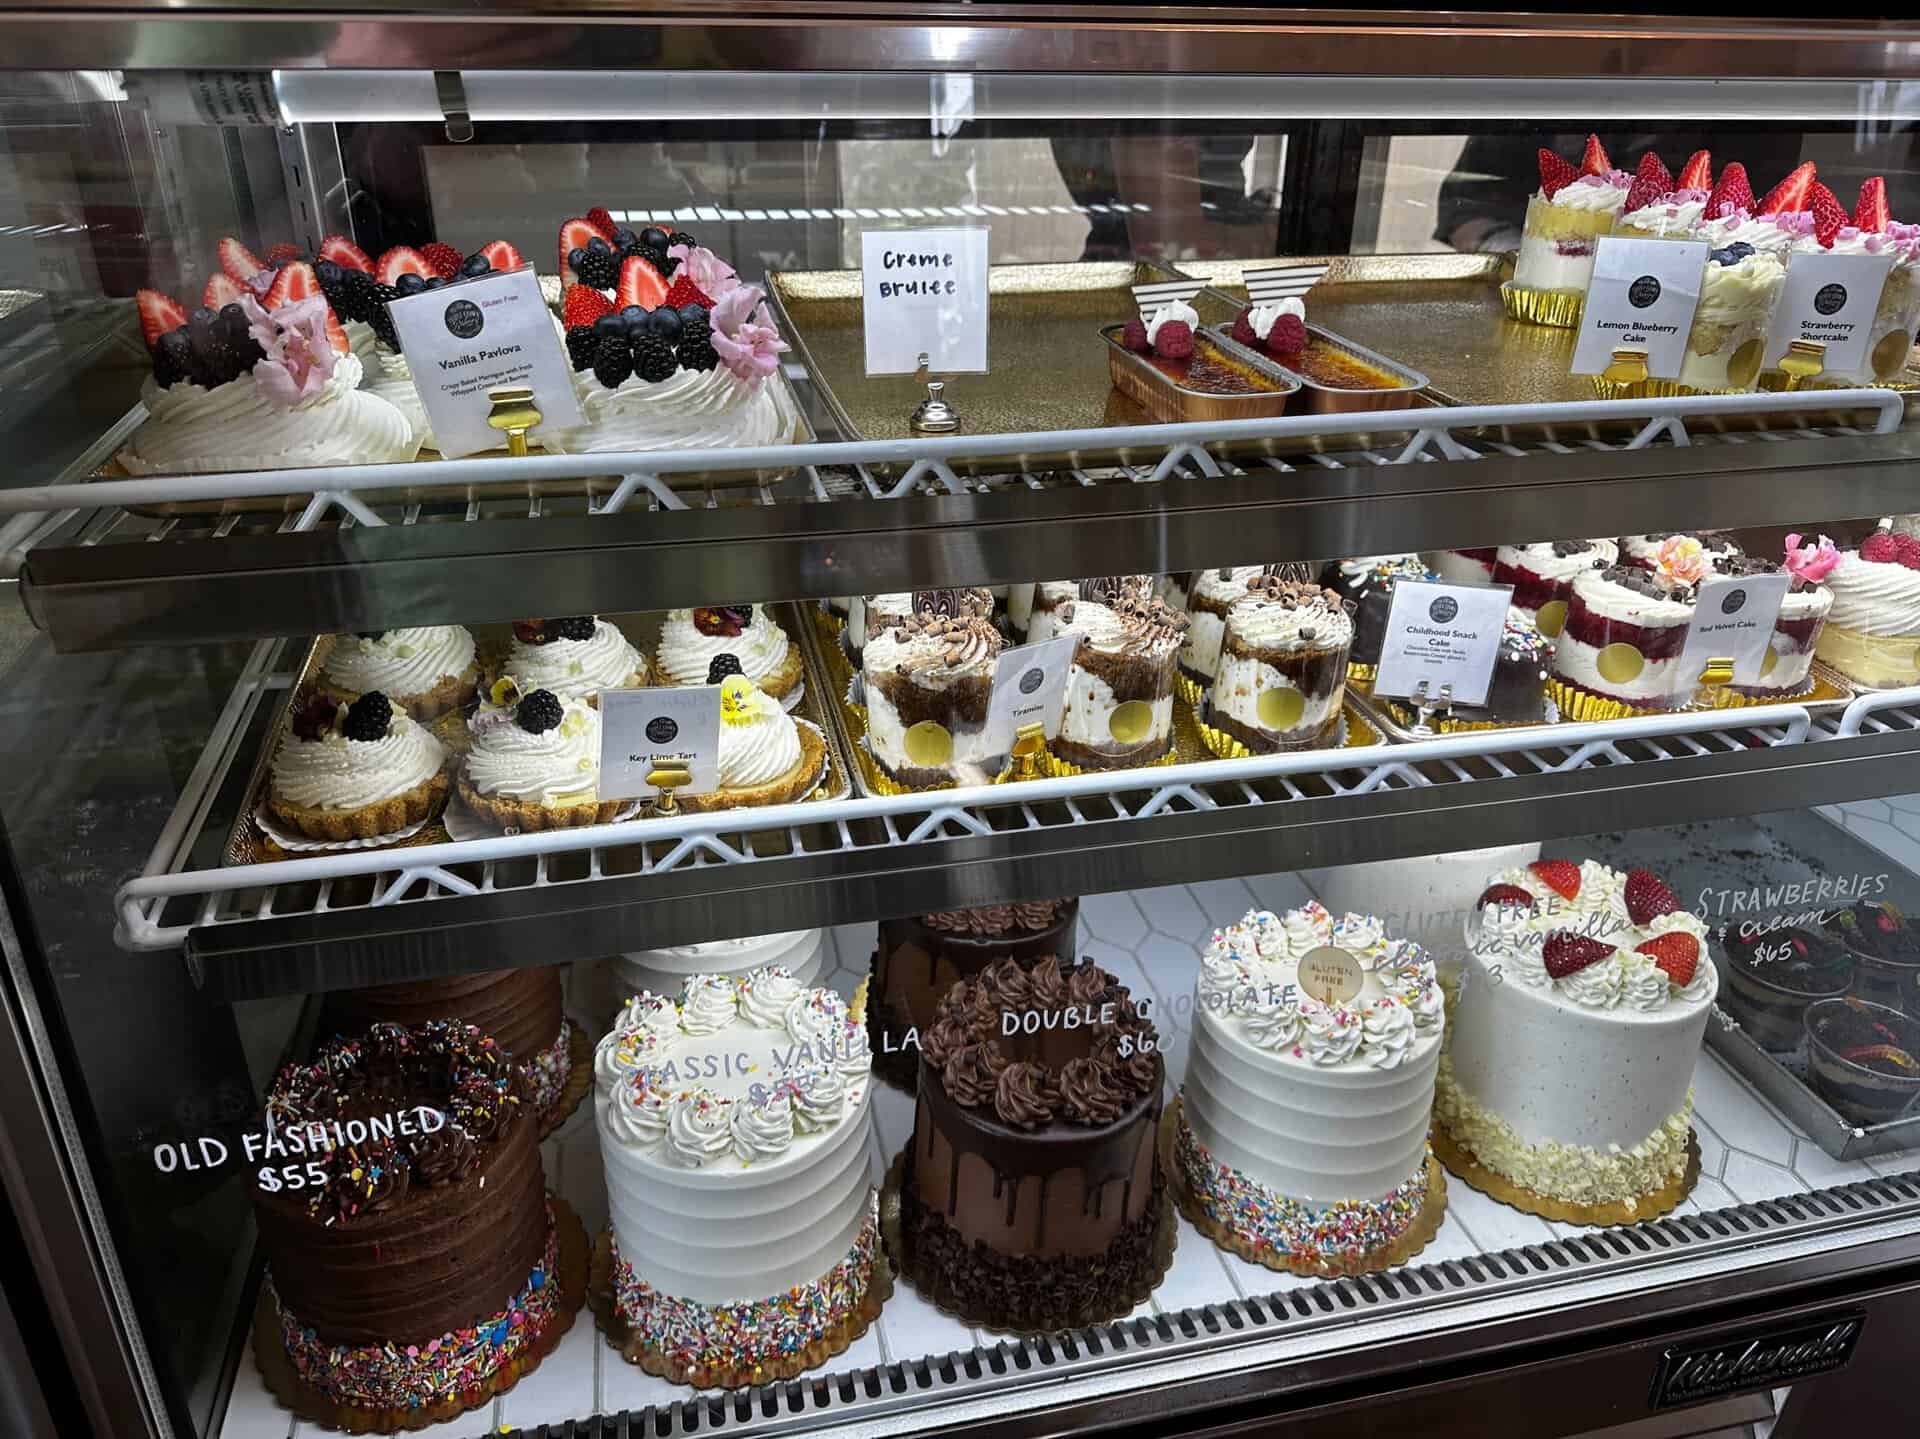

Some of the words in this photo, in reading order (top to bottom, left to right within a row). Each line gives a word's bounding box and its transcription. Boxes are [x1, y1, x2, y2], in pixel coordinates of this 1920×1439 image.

[883, 250, 953, 269] Creme
[880, 280, 956, 298] Brulee
[1597, 320, 1630, 330] Lemon
[1631, 322, 1678, 335] Blueberry
[1800, 320, 1855, 332] Strawberry
[1622, 334, 1647, 343] Cake
[1800, 332, 1849, 341] Shortcake
[438, 354, 478, 370] Vanilla
[479, 343, 522, 361] Pavlova
[1406, 626, 1450, 637] Childhood
[1451, 629, 1478, 640] Snack
[1428, 638, 1450, 647] Cake
[630, 754, 647, 763] Key
[650, 753, 674, 761] Lime
[677, 752, 697, 760] Tart
[1694, 874, 1889, 920] STRAWBERRIES
[1498, 894, 1561, 923] FREE
[1750, 939, 1792, 967] $65
[1001, 1002, 1117, 1036] DOUBLE
[153, 1137, 228, 1173] OLD
[242, 1105, 445, 1162] FASHIONED
[258, 1162, 328, 1192] $55
